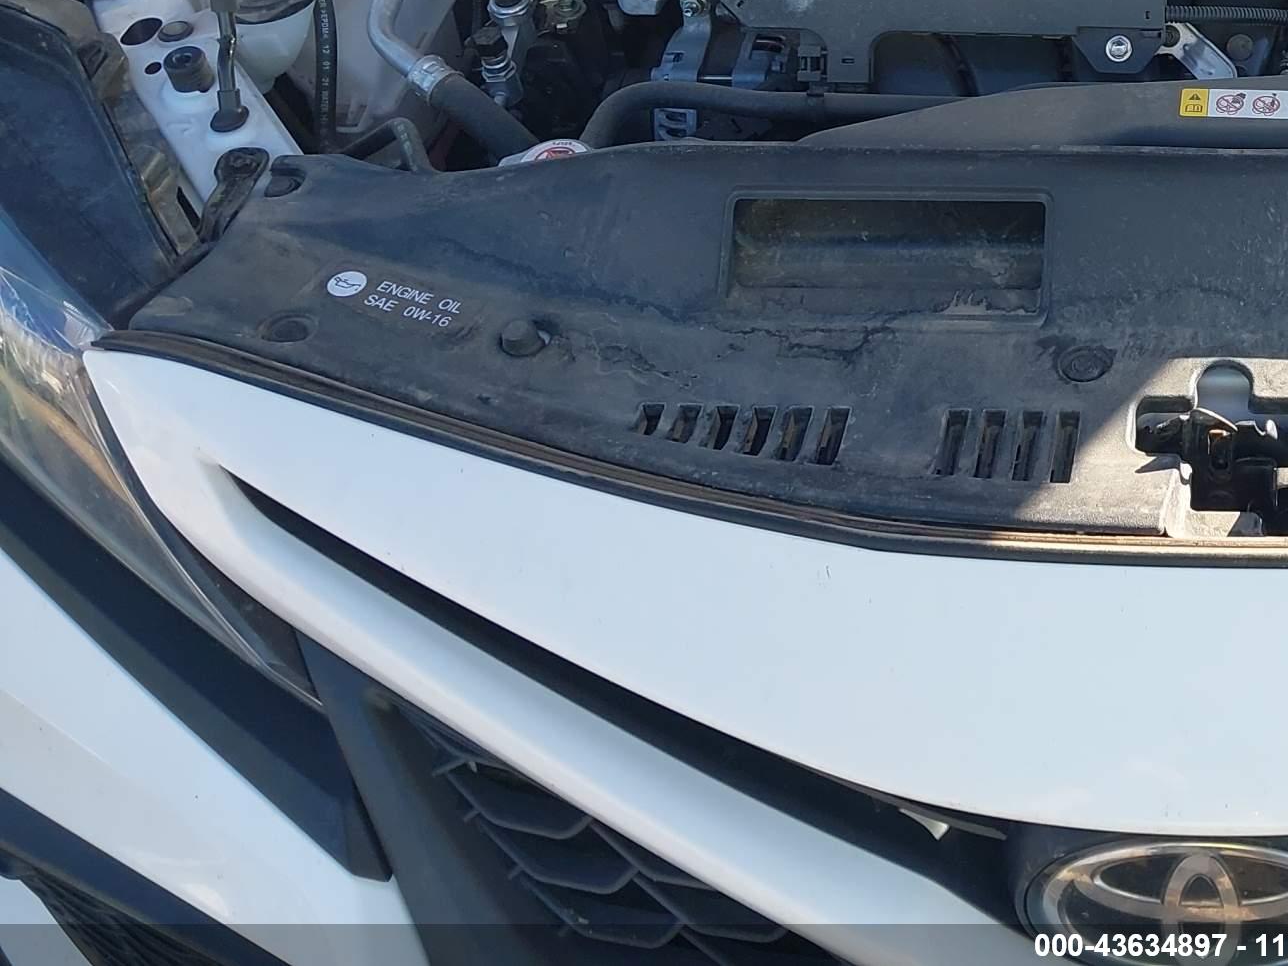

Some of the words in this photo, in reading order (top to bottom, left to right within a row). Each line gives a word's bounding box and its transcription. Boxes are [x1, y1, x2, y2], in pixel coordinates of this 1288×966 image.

[363, 294, 399, 312] SAE
[403, 306, 452, 327] 0W-16
[376, 280, 434, 305] ENGINE
[438, 298, 463, 314] OIL
